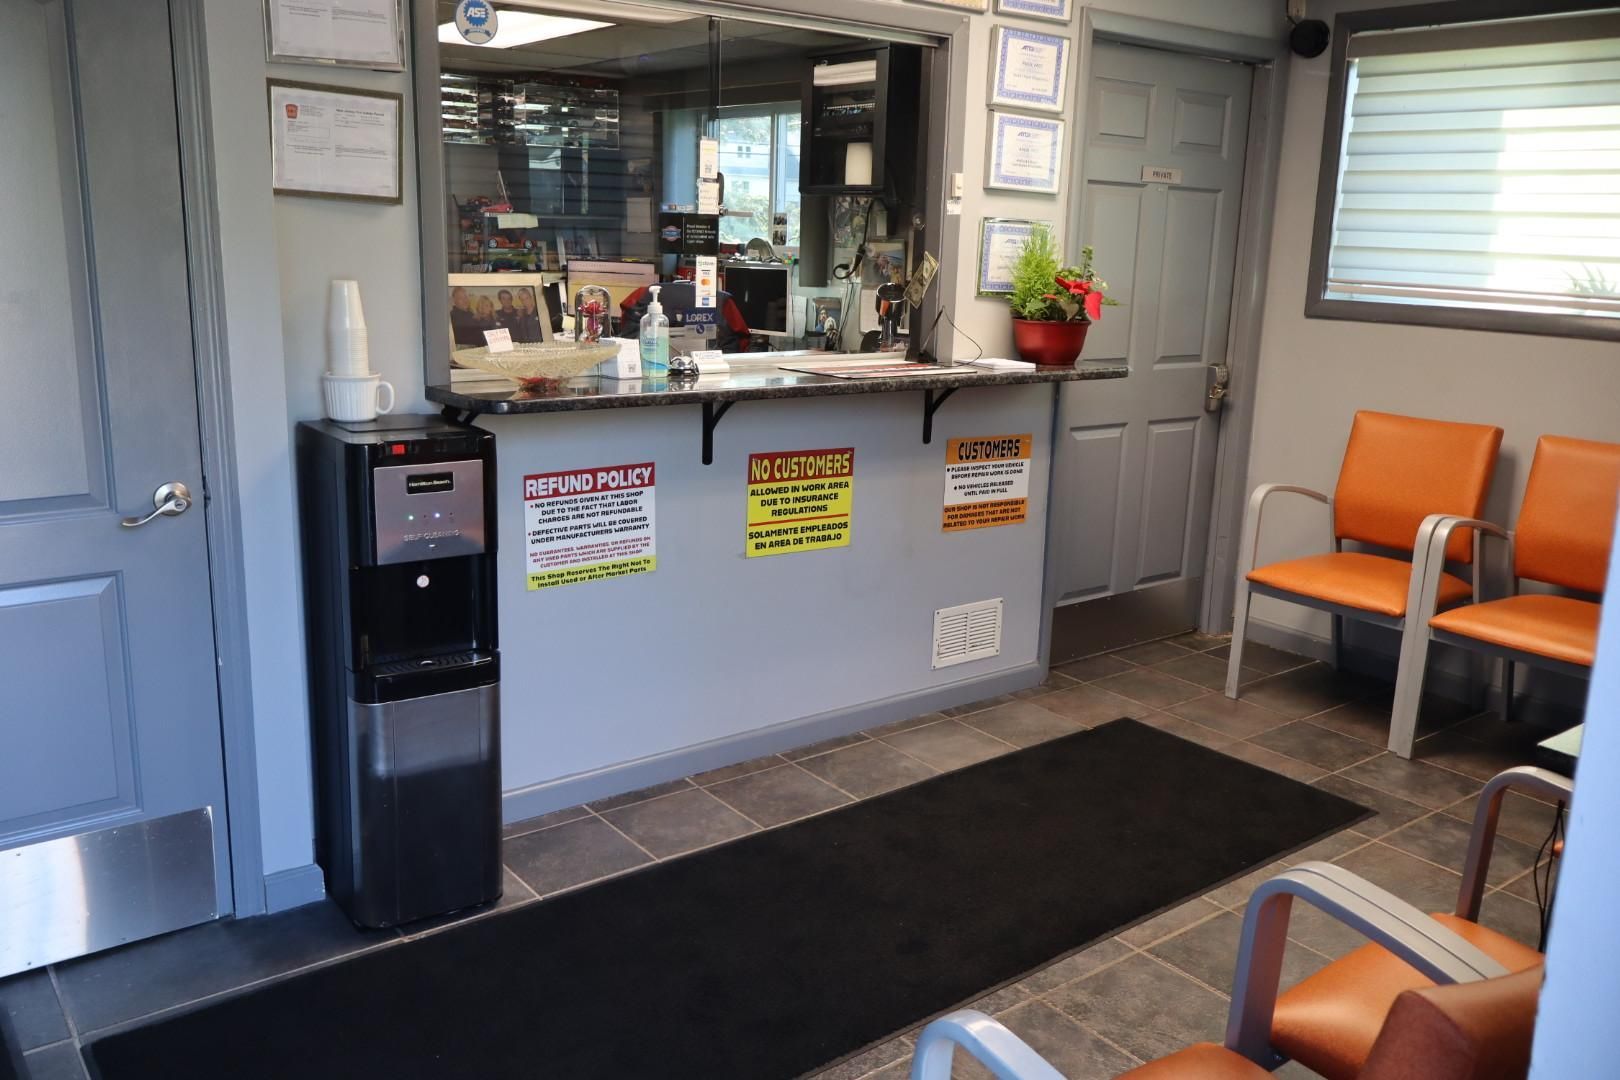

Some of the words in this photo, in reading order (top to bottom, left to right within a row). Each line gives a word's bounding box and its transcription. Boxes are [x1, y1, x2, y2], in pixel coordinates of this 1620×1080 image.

[466, 7, 486, 18] ASE
[686, 313, 714, 322] LOREX
[959, 439, 1020, 460] CUSTOMERS
[752, 459, 770, 481] NO
[774, 454, 850, 479] CUSTOMERS
[526, 474, 593, 498] REFUND
[597, 467, 652, 489] POLICY
[750, 486, 789, 496] ALLOWED
[802, 483, 825, 492] WORK
[547, 498, 578, 507] REFUNDS
[793, 493, 839, 503] INSURANCE
[538, 516, 570, 524] CHARGES
[601, 506, 643, 516] REFUNDABLE
[772, 505, 828, 516] REGULATIONS
[531, 536, 555, 545] UNDER
[556, 528, 613, 541] MANUFACTURERS
[614, 524, 650, 532] WARRANTY
[532, 527, 568, 536] DEFECTIVE
[570, 523, 591, 532] PARTS
[618, 516, 648, 525] COVERED
[749, 527, 798, 539] SOLAMENTE
[800, 522, 848, 532] EMPLEADOS
[769, 539, 791, 548] AREA
[805, 533, 842, 543] TRABAJO
[538, 580, 559, 588] Install
[561, 576, 578, 585] Used
[588, 572, 604, 580] After
[606, 568, 628, 578] Market
[548, 572, 565, 580] Shop
[567, 568, 596, 577] Reserves
[612, 560, 629, 570] Right
